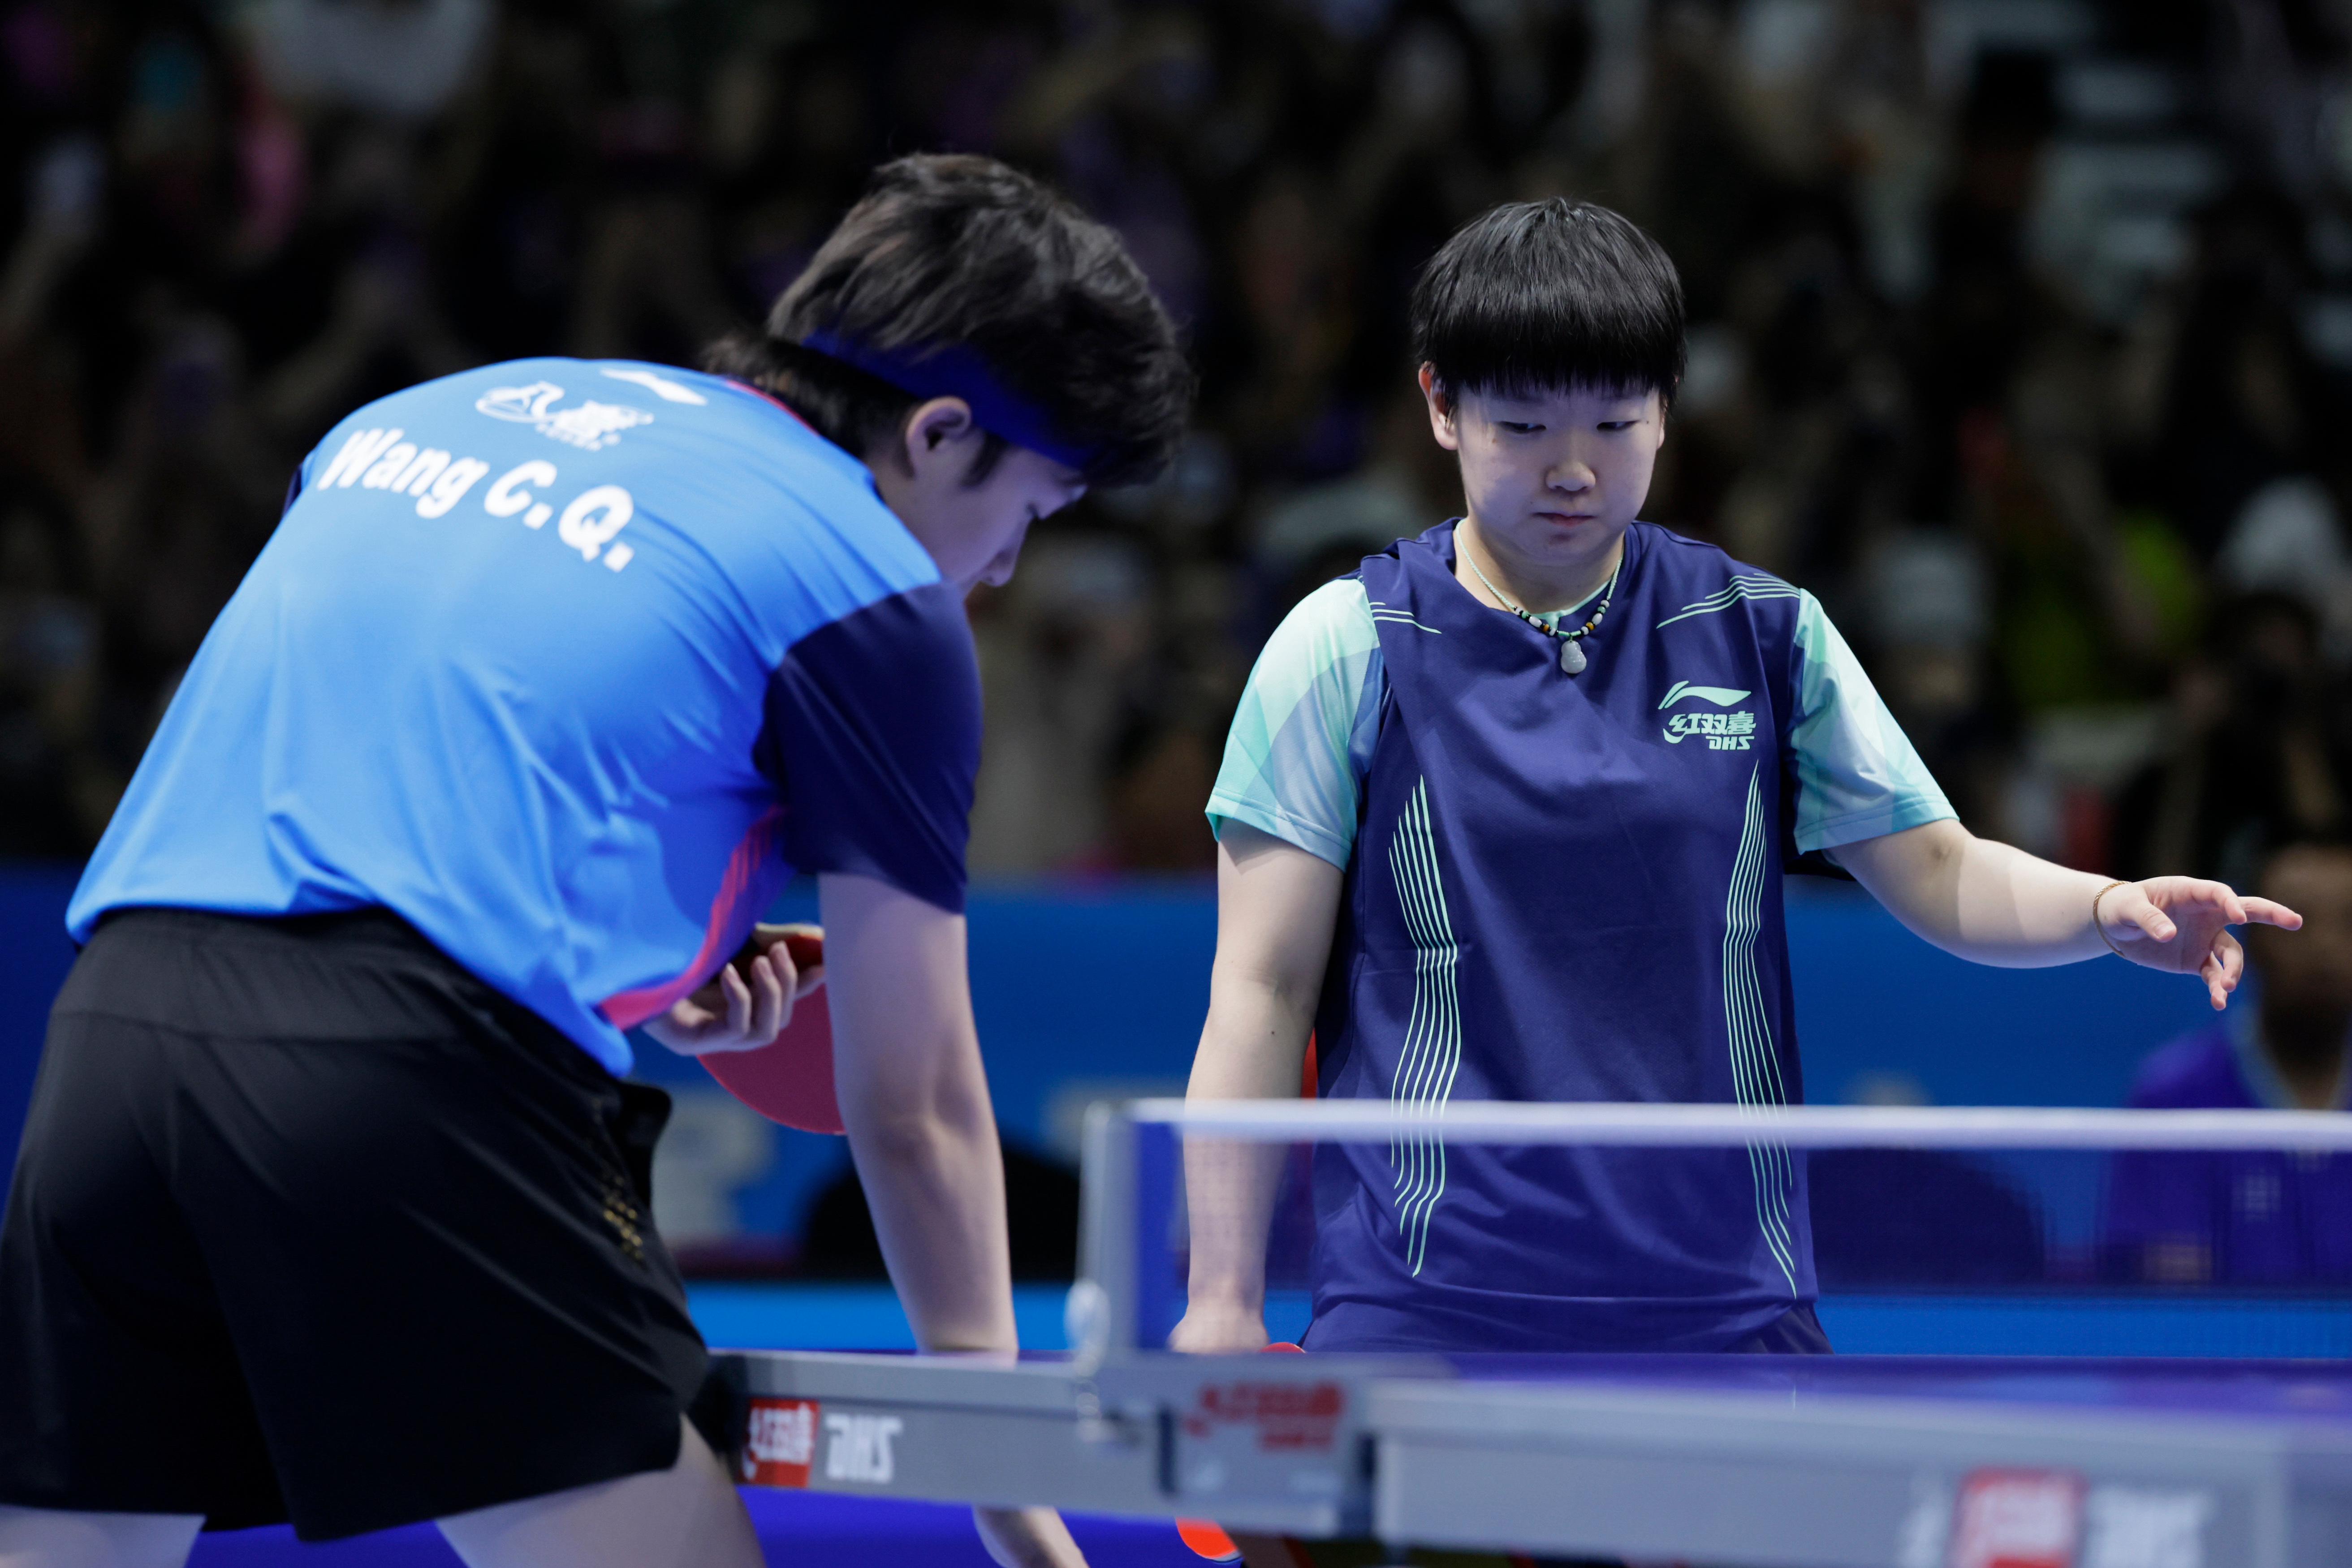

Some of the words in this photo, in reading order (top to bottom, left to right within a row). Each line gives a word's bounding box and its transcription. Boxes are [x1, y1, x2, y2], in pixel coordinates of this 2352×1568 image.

[317, 428, 490, 518] Wang
[1662, 710, 1756, 744] 红双喜
[1705, 735, 1755, 750] DHS
